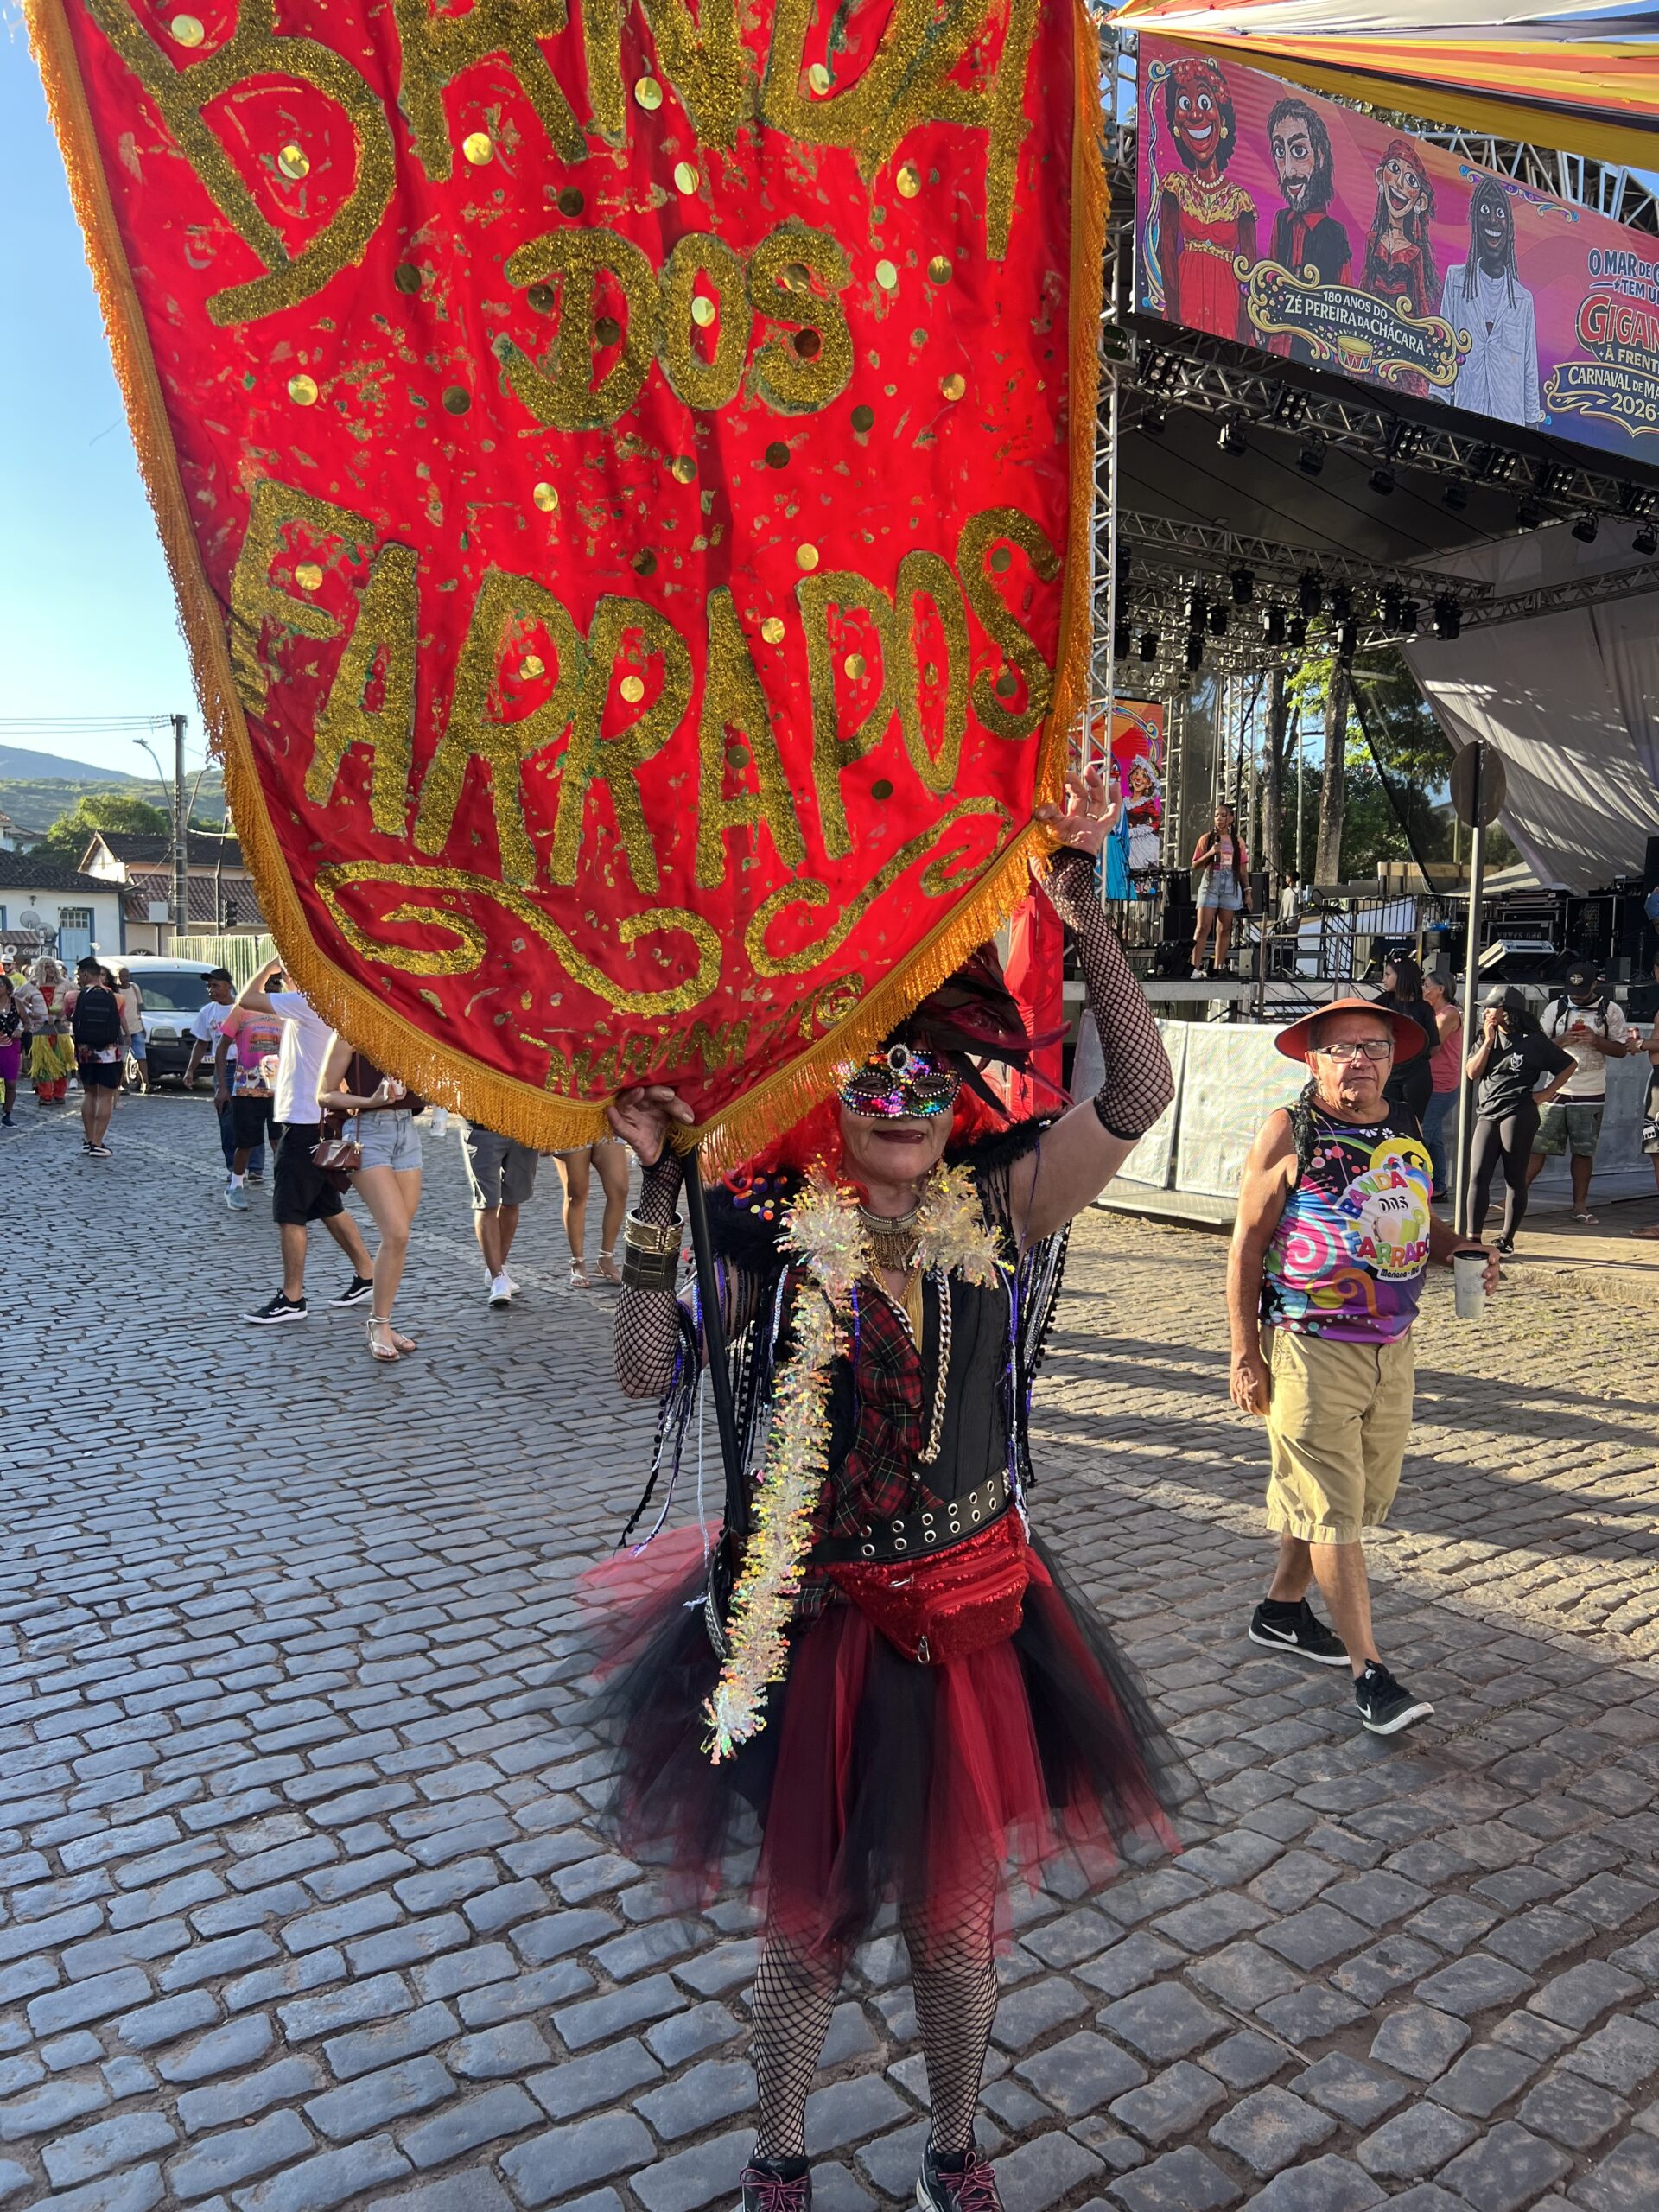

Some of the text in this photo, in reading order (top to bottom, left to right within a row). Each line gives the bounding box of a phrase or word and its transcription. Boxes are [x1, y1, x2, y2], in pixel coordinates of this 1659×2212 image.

[1588, 248, 1602, 277] O
[1604, 249, 1637, 278] MAR
[1638, 262, 1651, 279] DE
[1621, 279, 1645, 298] TEM
[1323, 290, 1388, 320] 180 ANOS DO
[494, 218, 855, 429] DOS
[1284, 294, 1426, 356] ZÉ PEREIRA DA CHÁCARA
[1618, 348, 1659, 375] FRENT
[1568, 366, 1631, 391] CARNAVAL
[1632, 379, 1643, 393] DE
[1611, 392, 1656, 422] 2026
[229, 478, 1062, 895] FARRAPOS
[1339, 1171, 1408, 1219] BANDA
[1378, 1196, 1409, 1212] DOS
